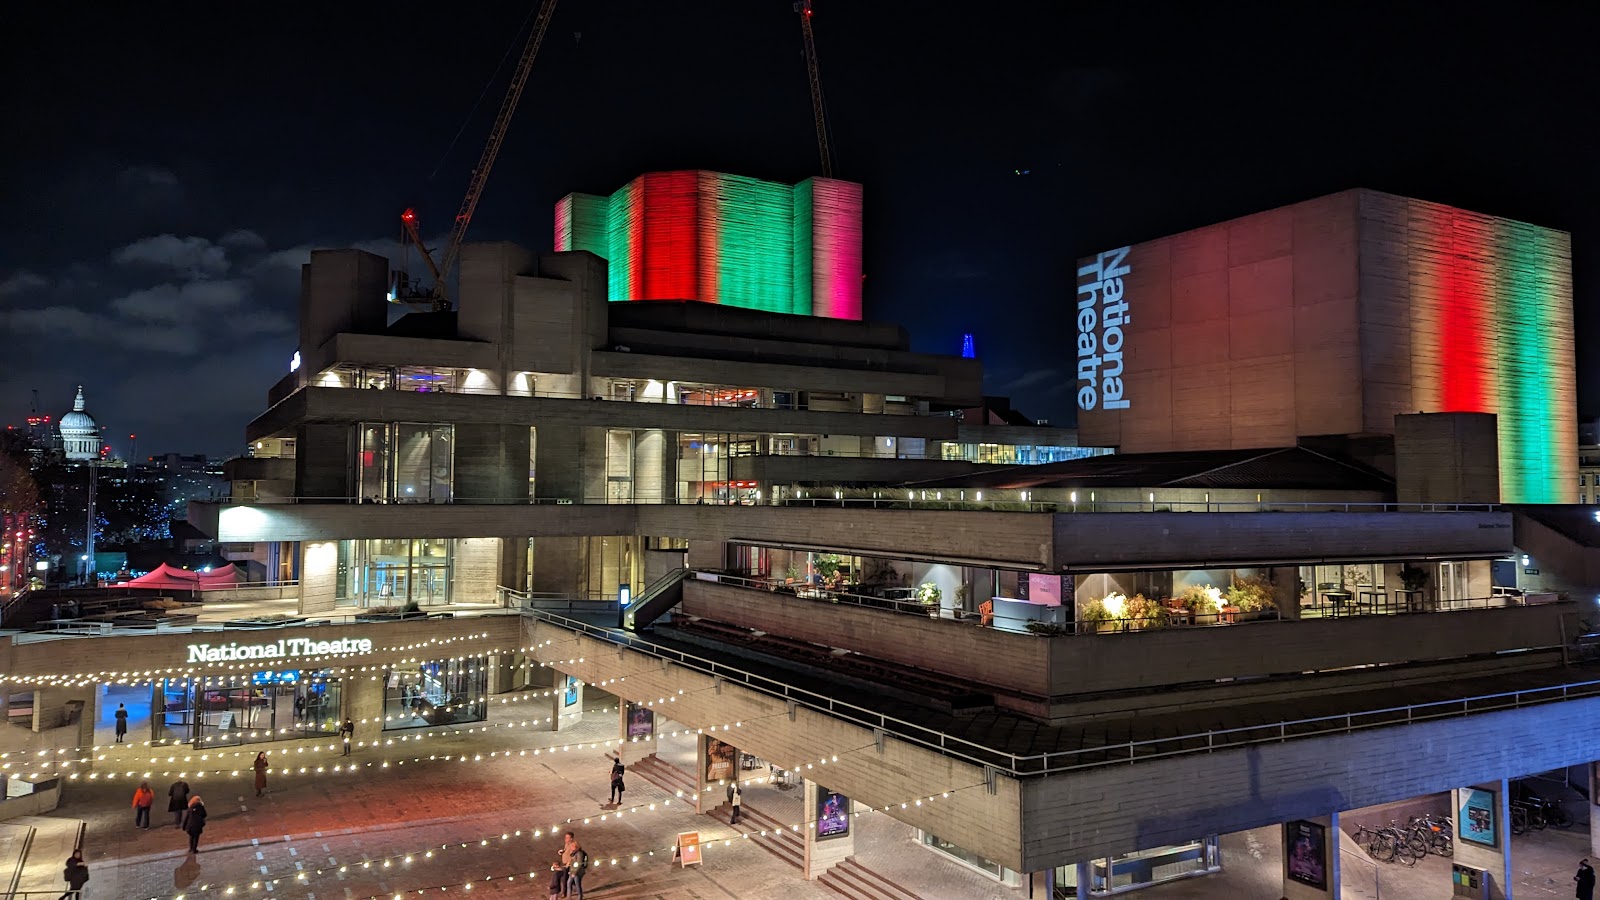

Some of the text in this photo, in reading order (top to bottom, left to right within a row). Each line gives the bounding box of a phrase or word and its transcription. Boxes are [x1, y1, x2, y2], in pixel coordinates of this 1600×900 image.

[1077, 253, 1102, 411] Theatre
[1103, 246, 1130, 409] National
[186, 637, 372, 663] National Theatre
